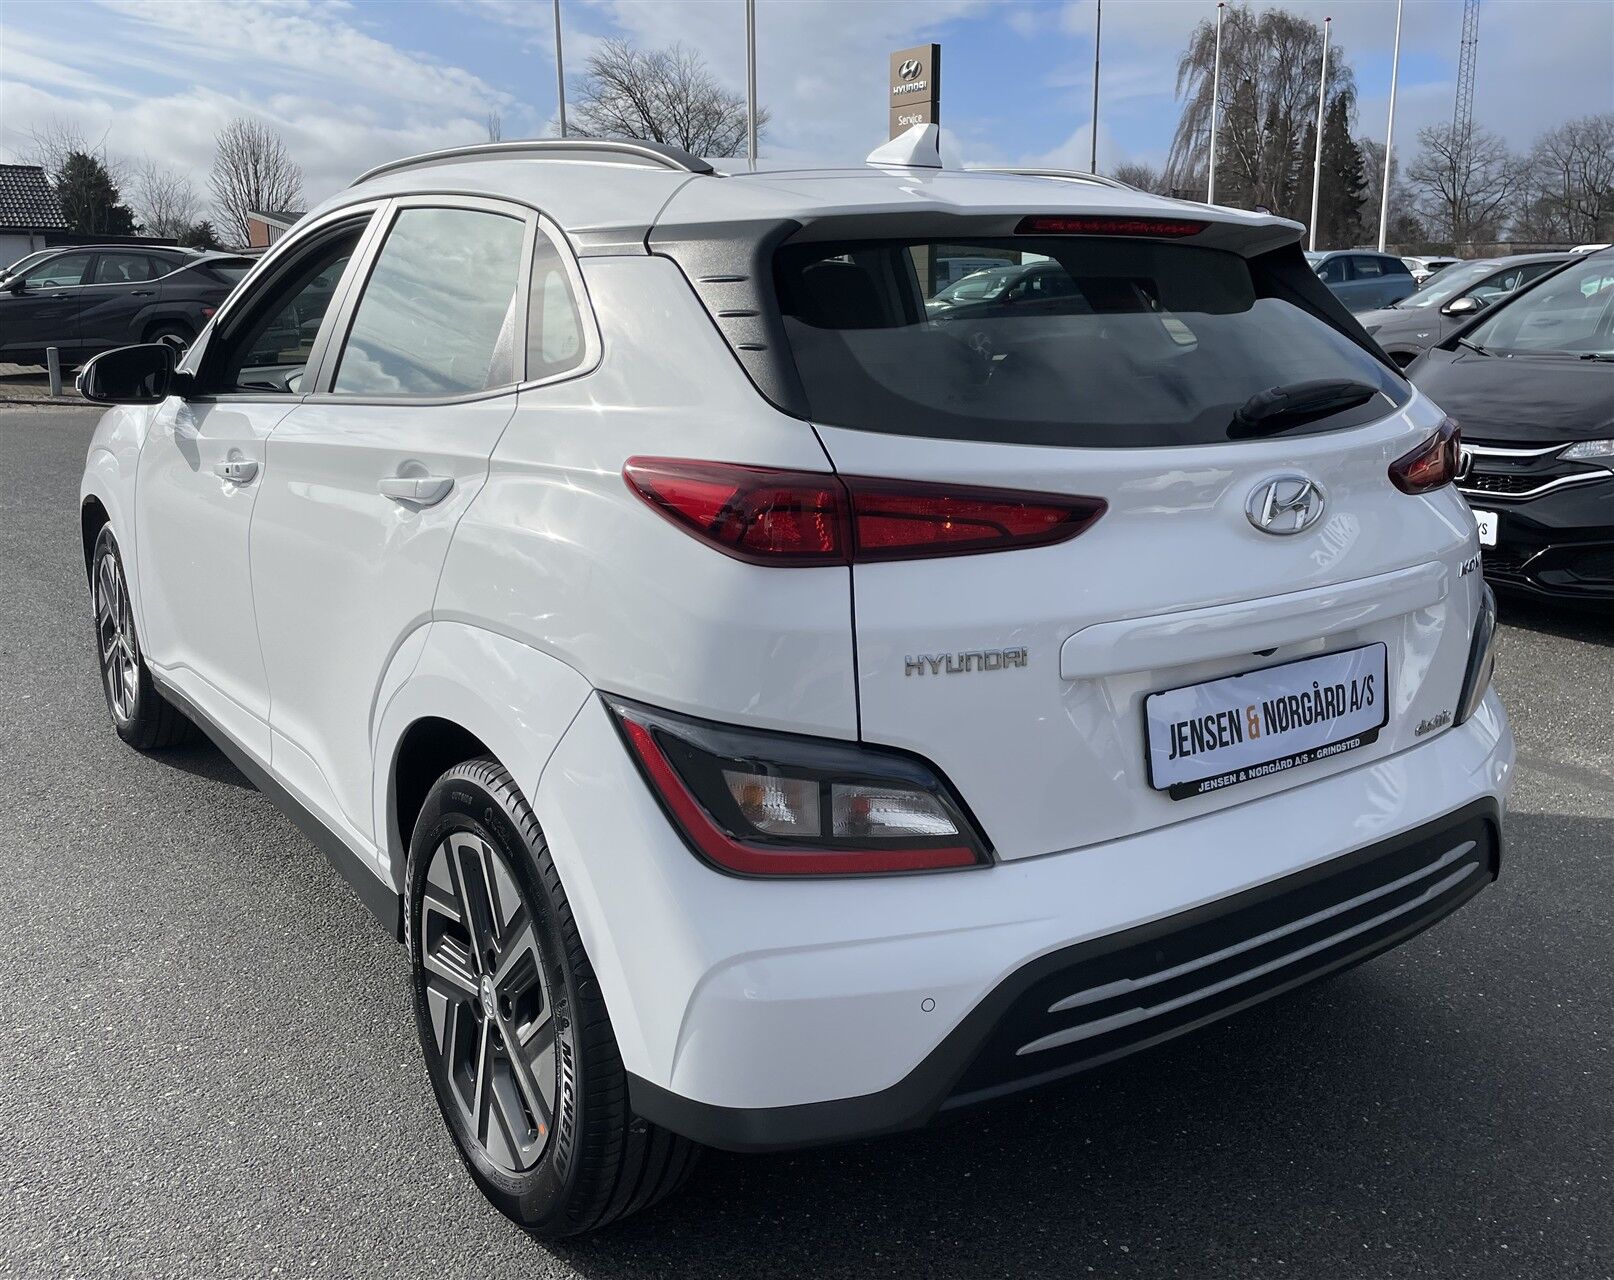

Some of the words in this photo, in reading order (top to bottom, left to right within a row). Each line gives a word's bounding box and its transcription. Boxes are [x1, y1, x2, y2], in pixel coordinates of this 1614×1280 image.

[893, 80, 927, 94] HYUNDAI
[898, 113, 922, 126] Service
[904, 646, 1028, 676] HYUNDAI
[1169, 708, 1243, 760] JENSEN
[1246, 705, 1260, 740] &
[1262, 681, 1346, 735] NØRGÅRD
[1350, 674, 1374, 712] A/S
[1198, 773, 1237, 792] JENSEN
[1239, 771, 1247, 781] &
[1249, 759, 1293, 779] NØRGÅRD
[1294, 753, 1309, 766] A/S
[1316, 738, 1360, 759] GRINDSTED
[555, 1039, 574, 1178] MICHELIN
